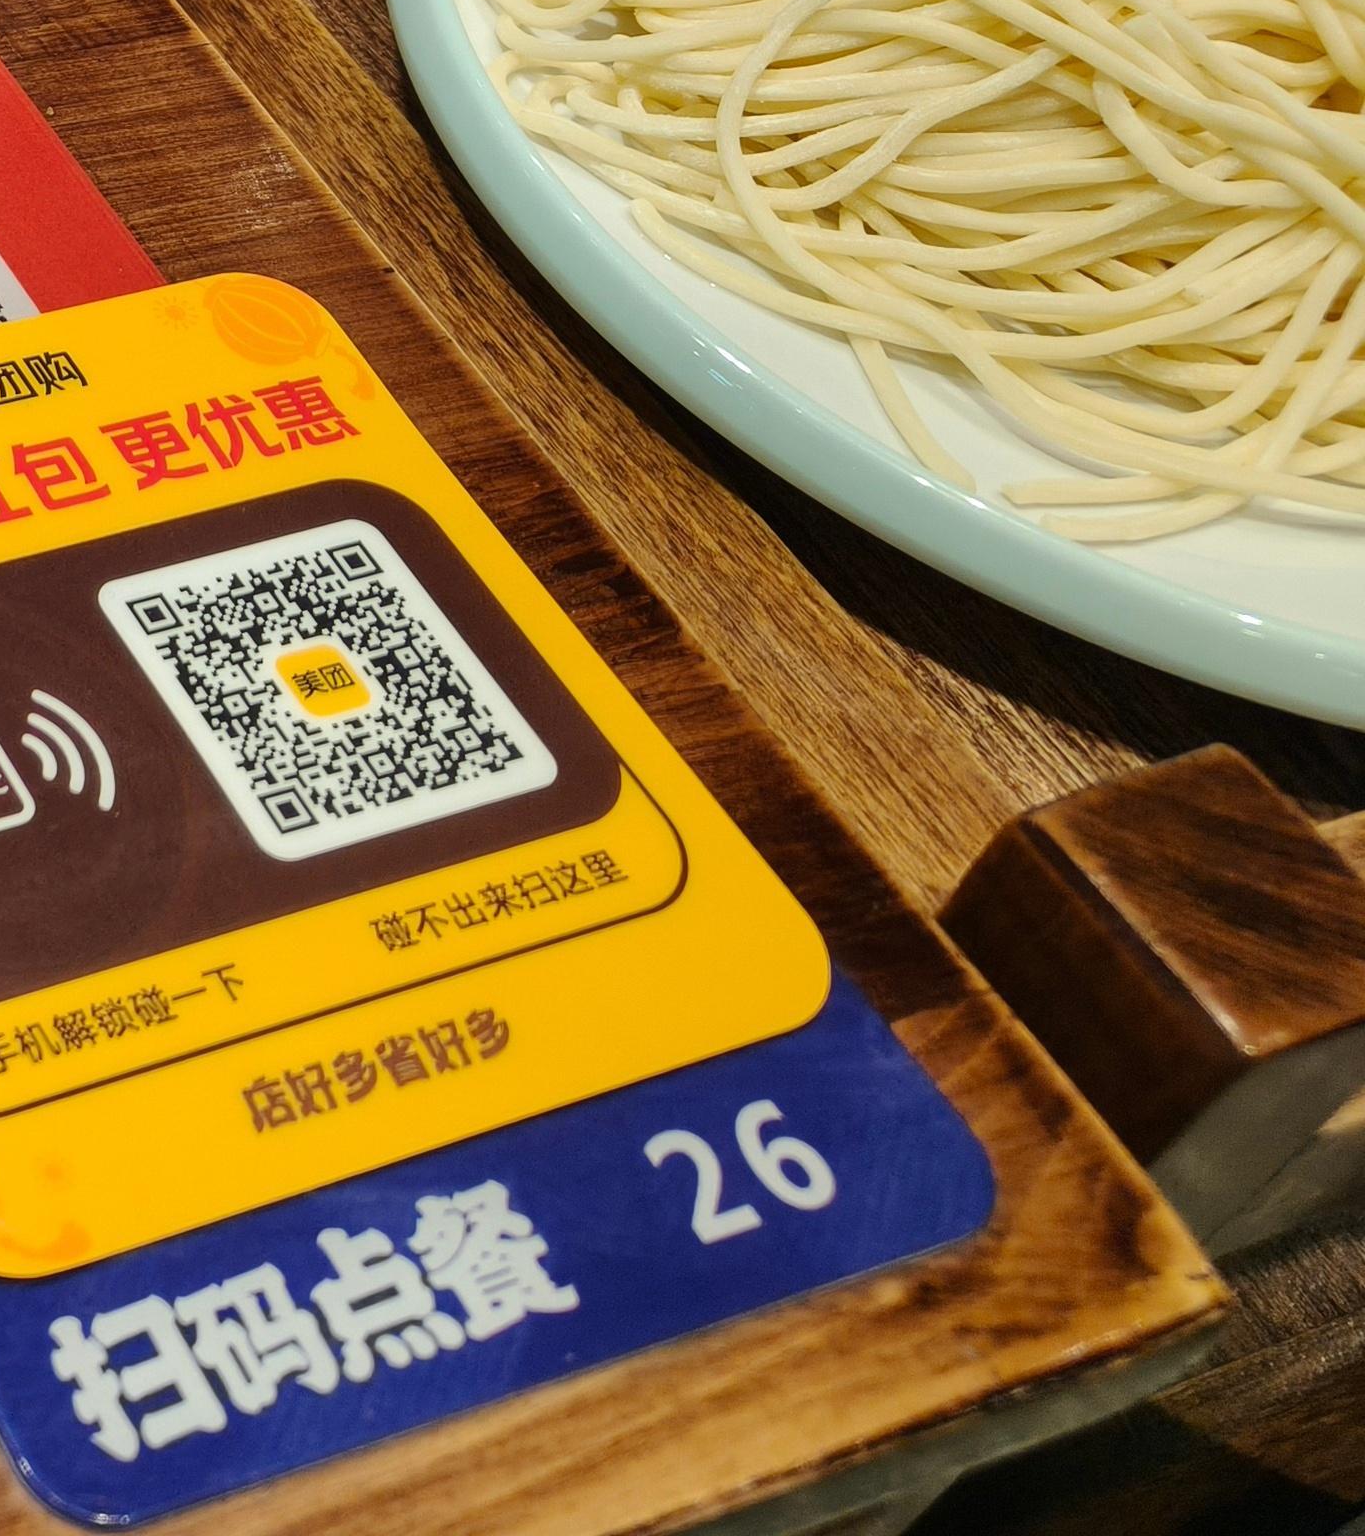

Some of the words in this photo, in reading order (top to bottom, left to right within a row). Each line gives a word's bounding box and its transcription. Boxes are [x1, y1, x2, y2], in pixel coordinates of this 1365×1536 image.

[100, 373, 362, 492] 更优惠
[291, 662, 356, 700] 美团
[369, 848, 629, 953] 碰不出来扫这里
[241, 1006, 510, 1134] 店好多省好多
[48, 1179, 580, 1463] 扫码点餐
[642, 1098, 838, 1246] 26
